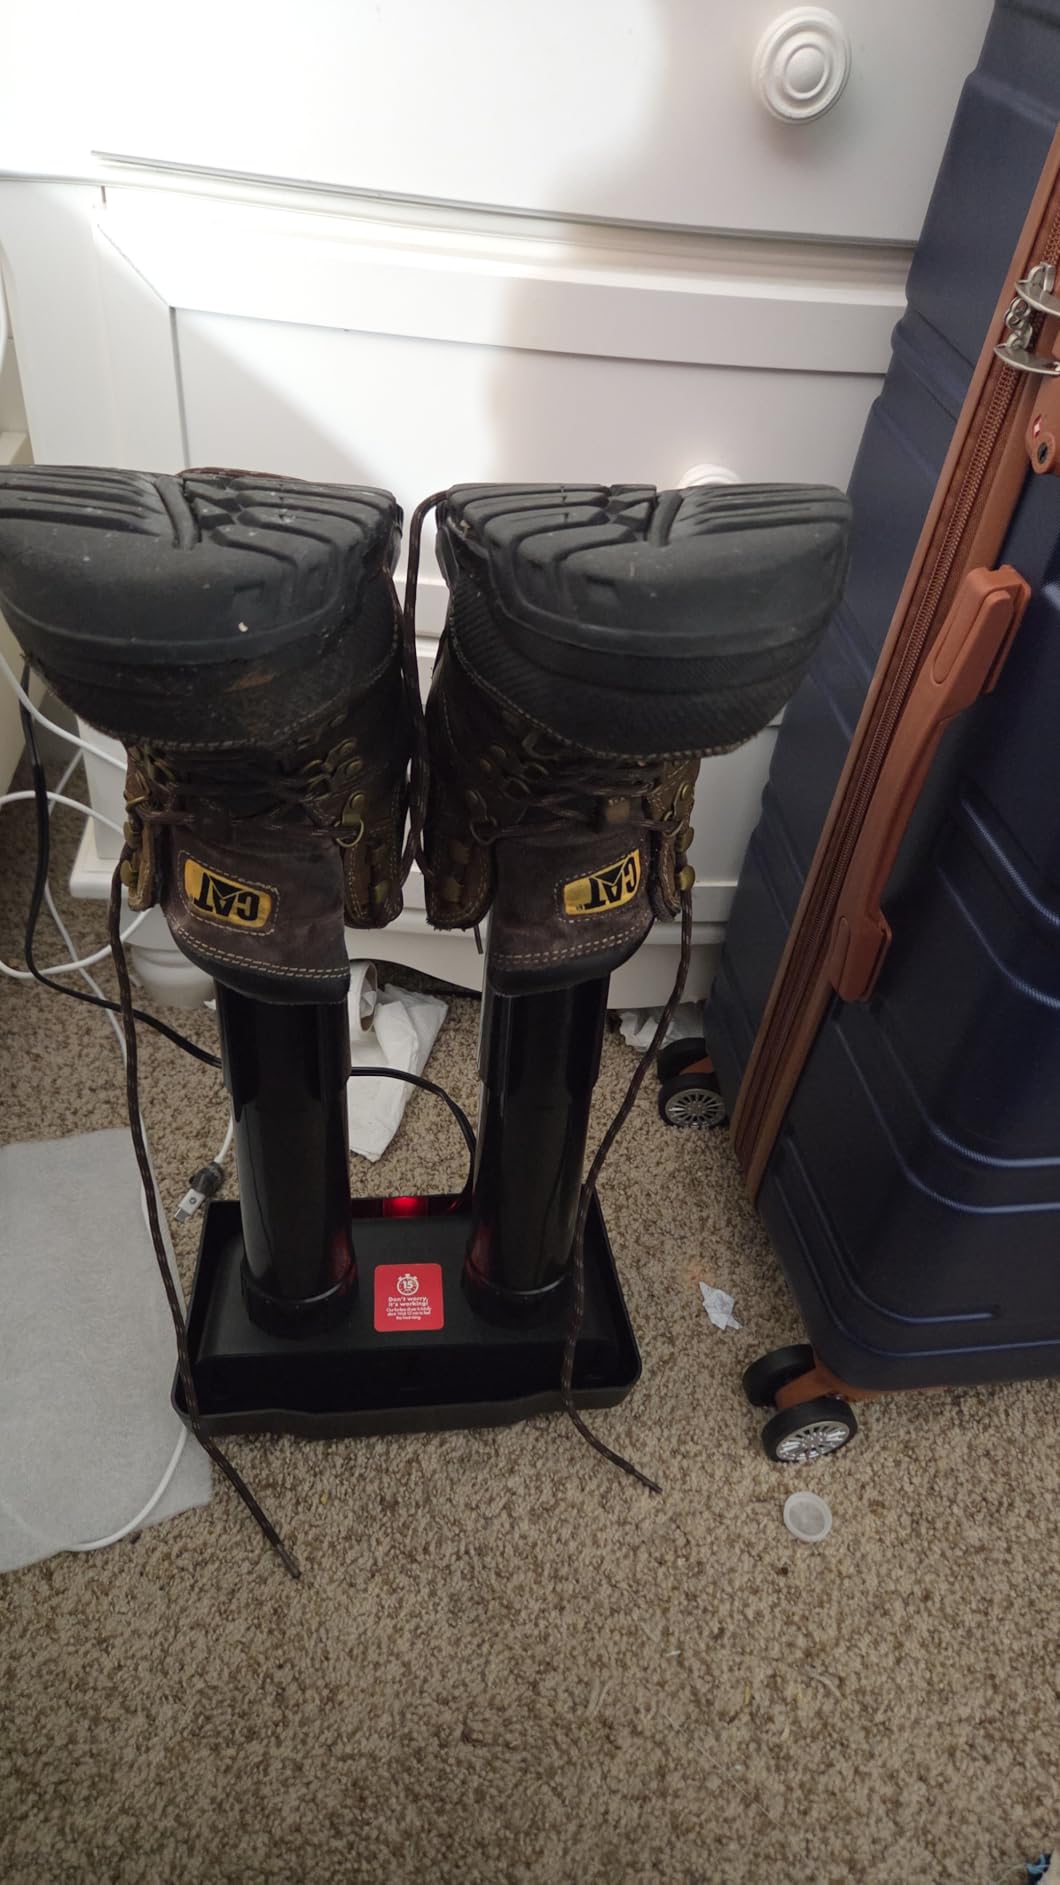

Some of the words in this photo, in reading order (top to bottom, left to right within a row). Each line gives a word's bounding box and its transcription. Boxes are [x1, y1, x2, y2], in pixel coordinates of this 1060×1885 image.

[194, 872, 259, 921] CAT
[583, 857, 637, 910] CAT
[402, 1280, 414, 1289] 15
